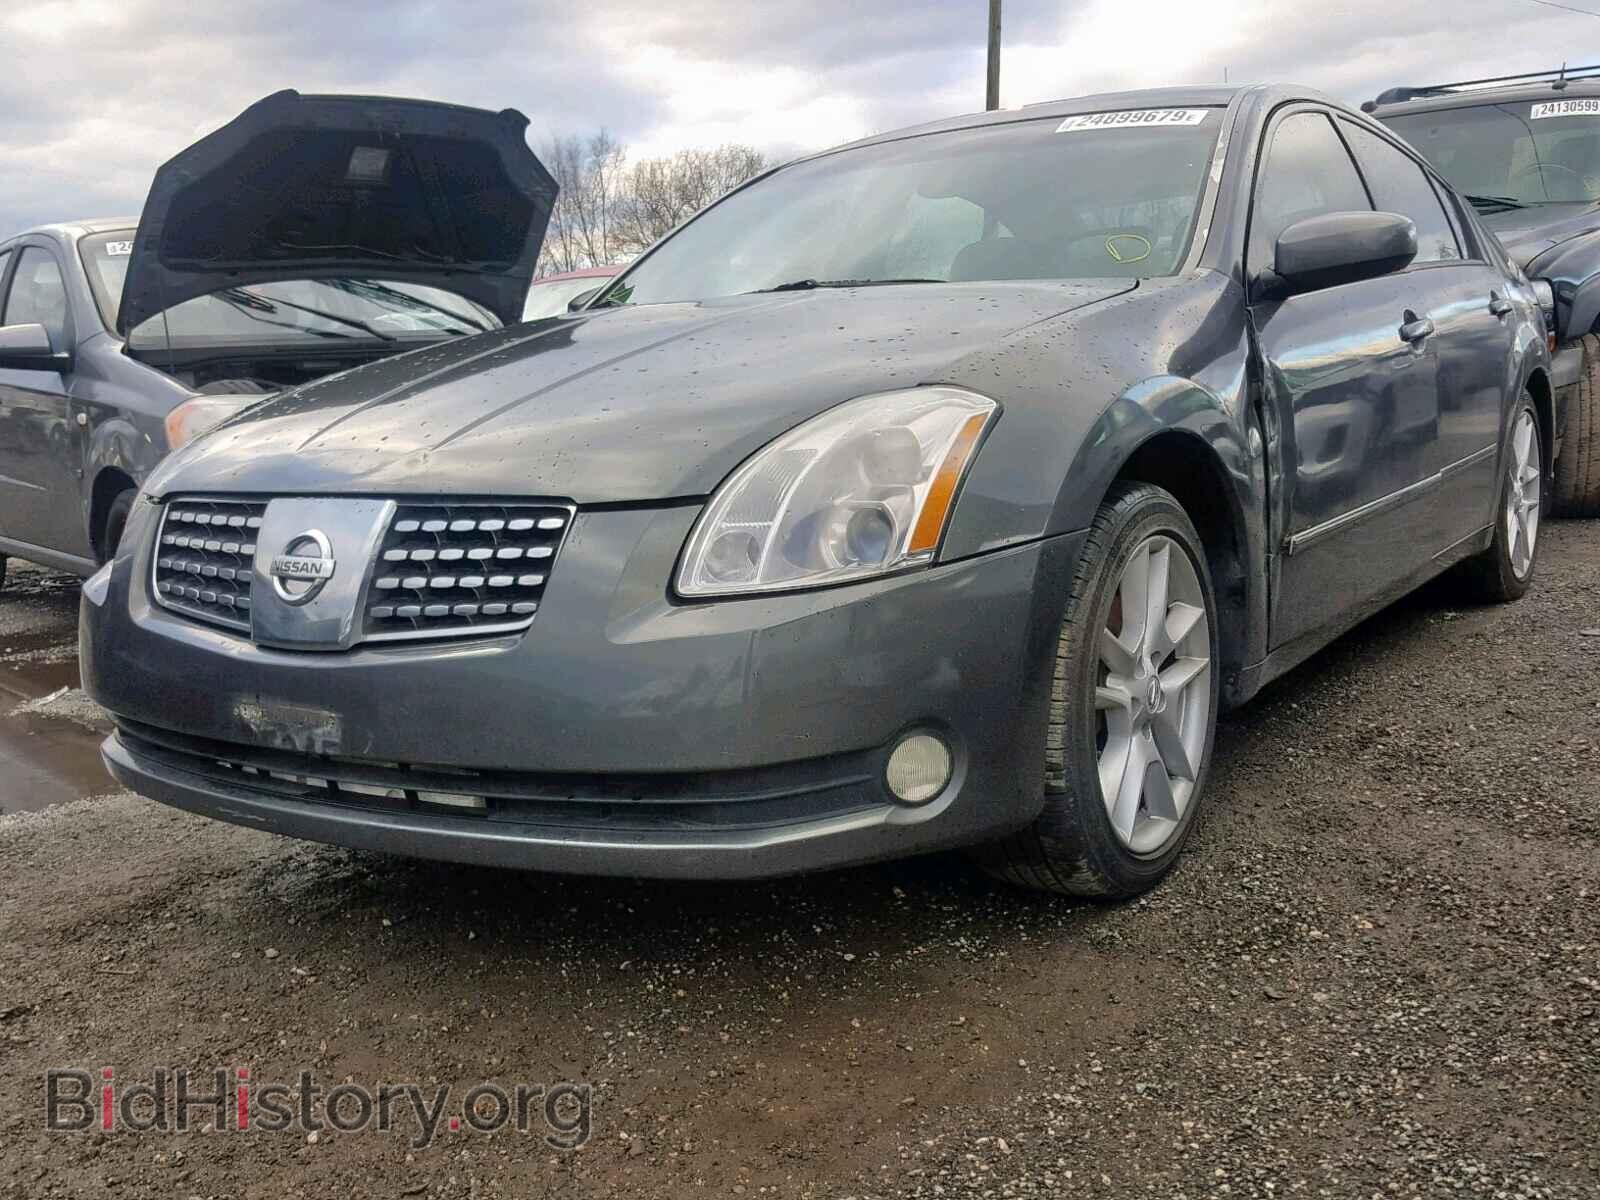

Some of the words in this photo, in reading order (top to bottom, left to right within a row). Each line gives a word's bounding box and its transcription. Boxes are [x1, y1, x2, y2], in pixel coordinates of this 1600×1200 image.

[1541, 101, 1599, 115] 24130599
[1076, 110, 1186, 127] 24899679
[271, 559, 322, 574] NISSAN
